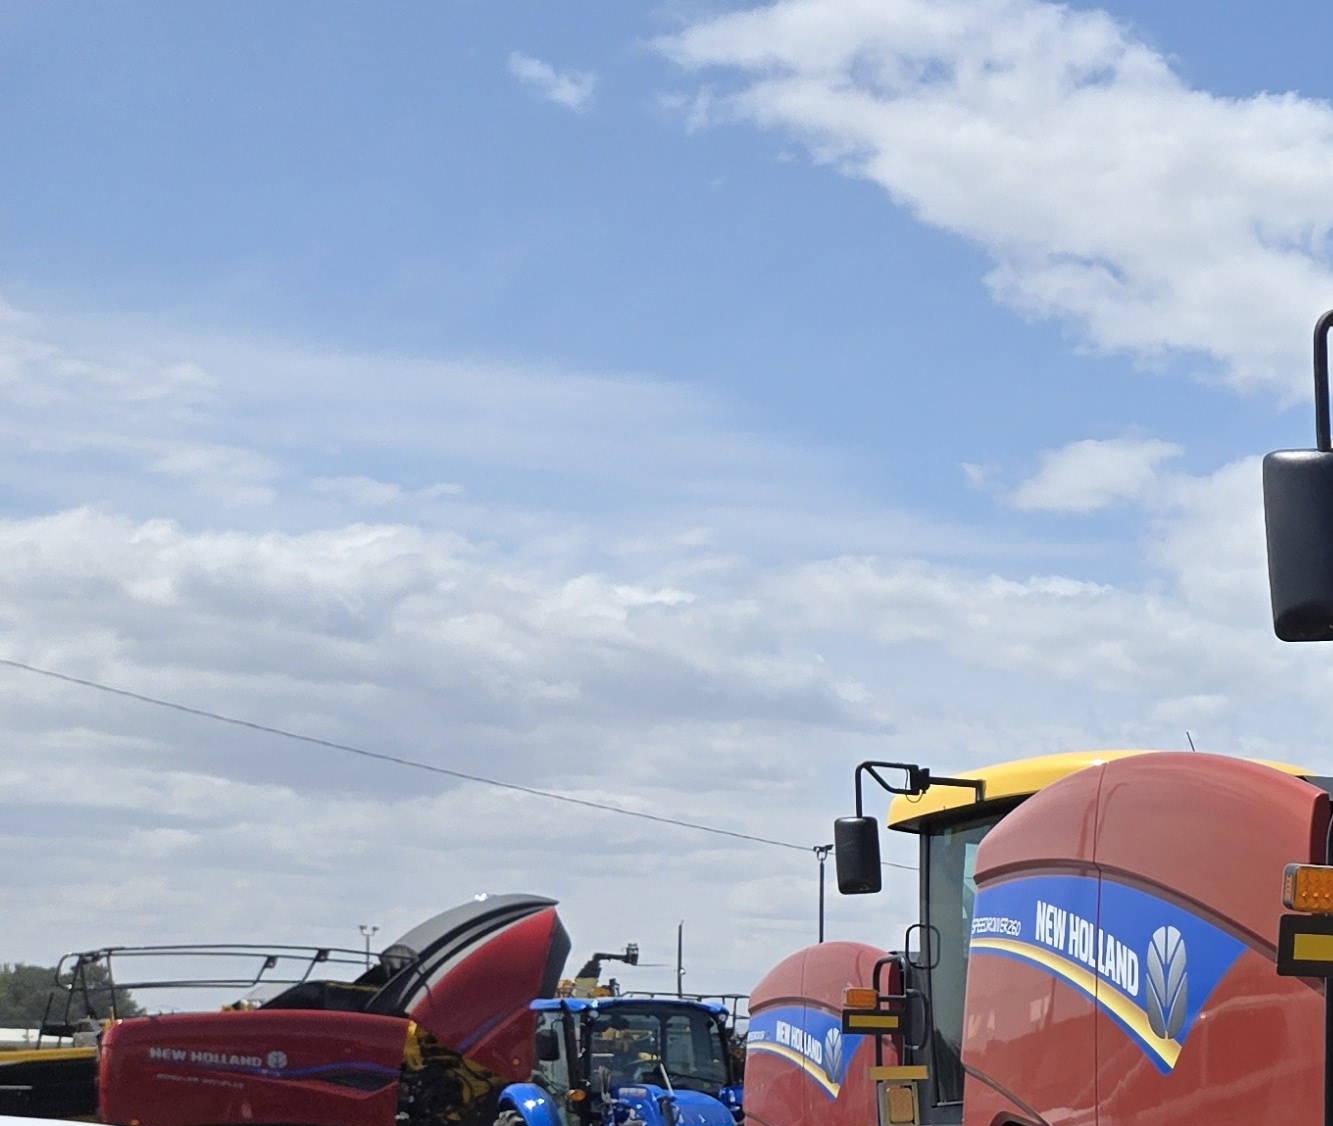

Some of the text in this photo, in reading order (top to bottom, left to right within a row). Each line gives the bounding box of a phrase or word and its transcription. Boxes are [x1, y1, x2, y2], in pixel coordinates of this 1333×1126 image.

[1035, 900, 1139, 997] NEW HOLLAND
[150, 1047, 263, 1068] NEW HOLLAND
[776, 1020, 822, 1065] NEW HOLLAND
